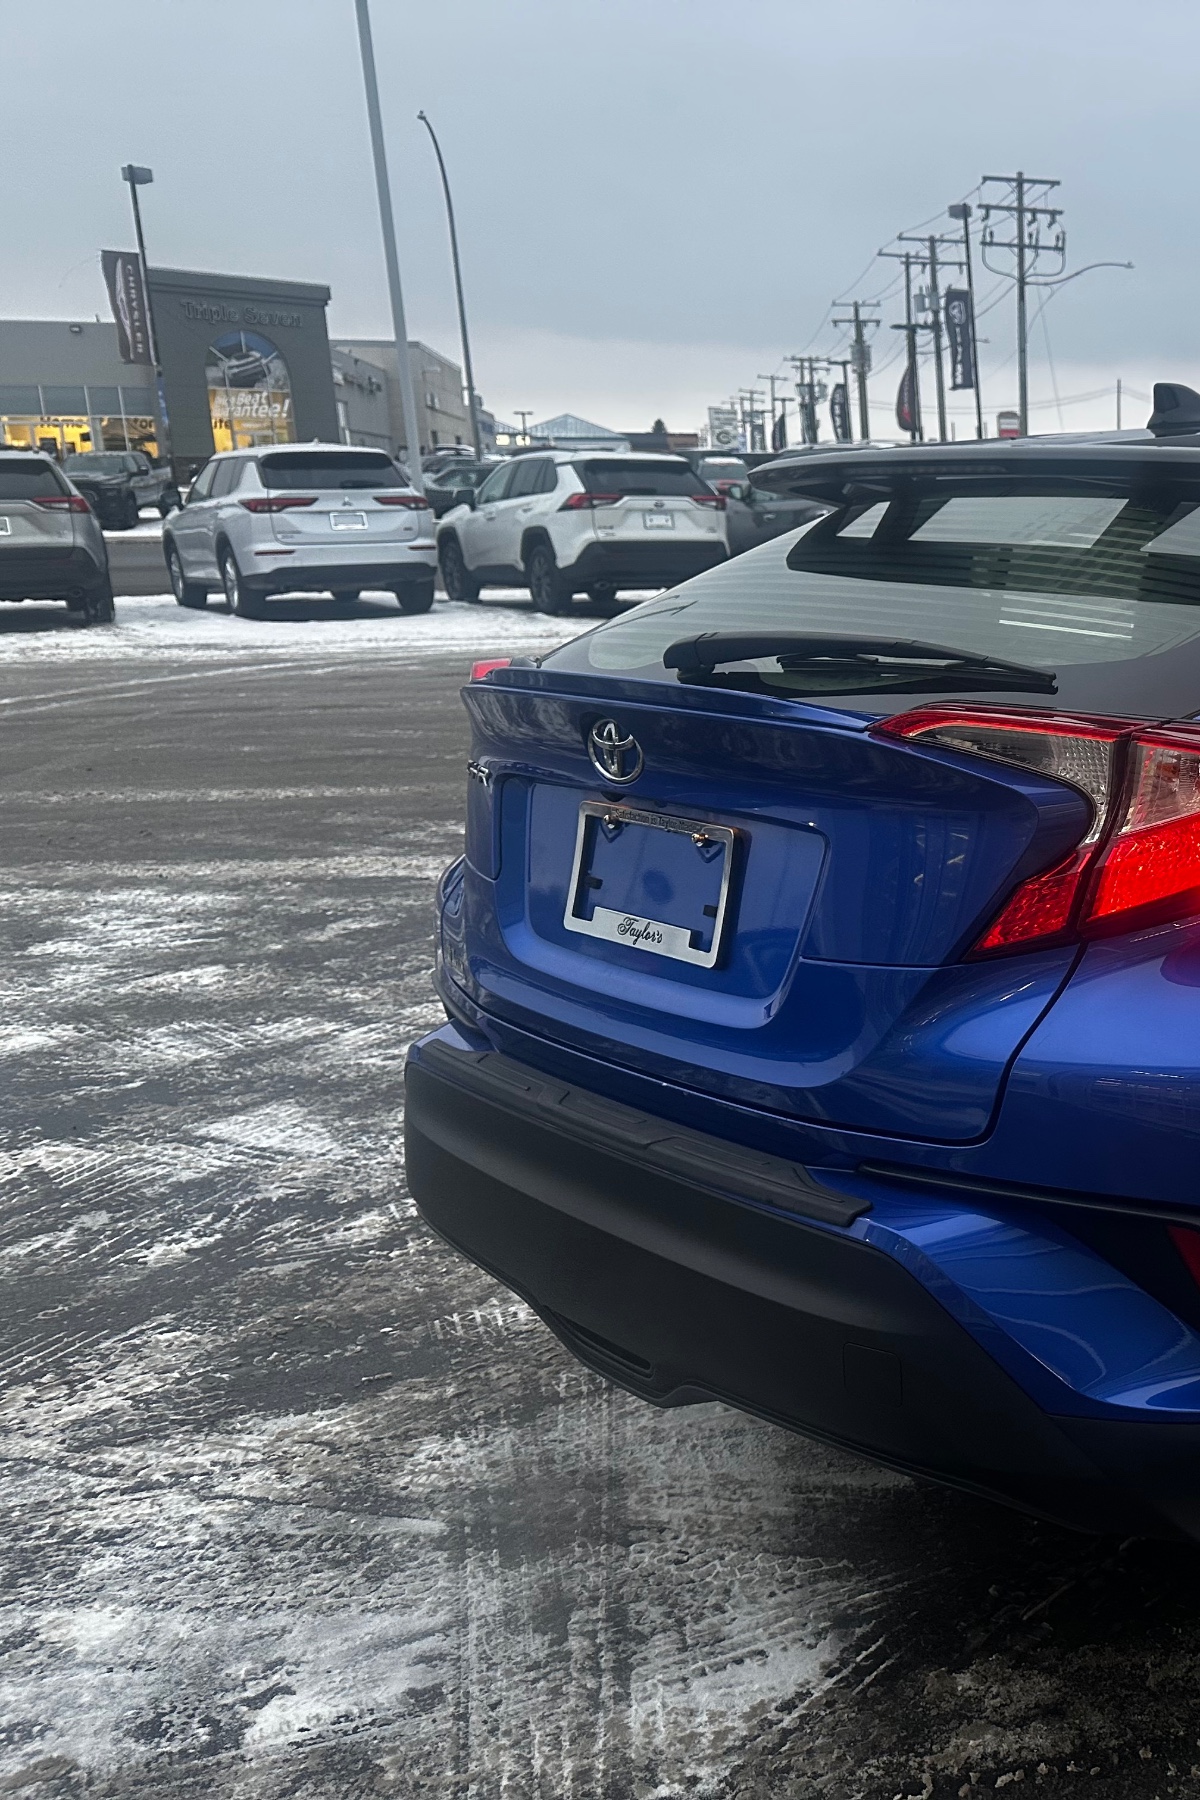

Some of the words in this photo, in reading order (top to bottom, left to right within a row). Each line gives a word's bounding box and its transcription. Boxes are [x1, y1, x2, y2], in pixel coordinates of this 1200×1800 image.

[181, 301, 239, 325] Triple
[243, 306, 302, 327] Seven
[236, 391, 268, 406] Beat
[617, 917, 663, 946] Taylor's
